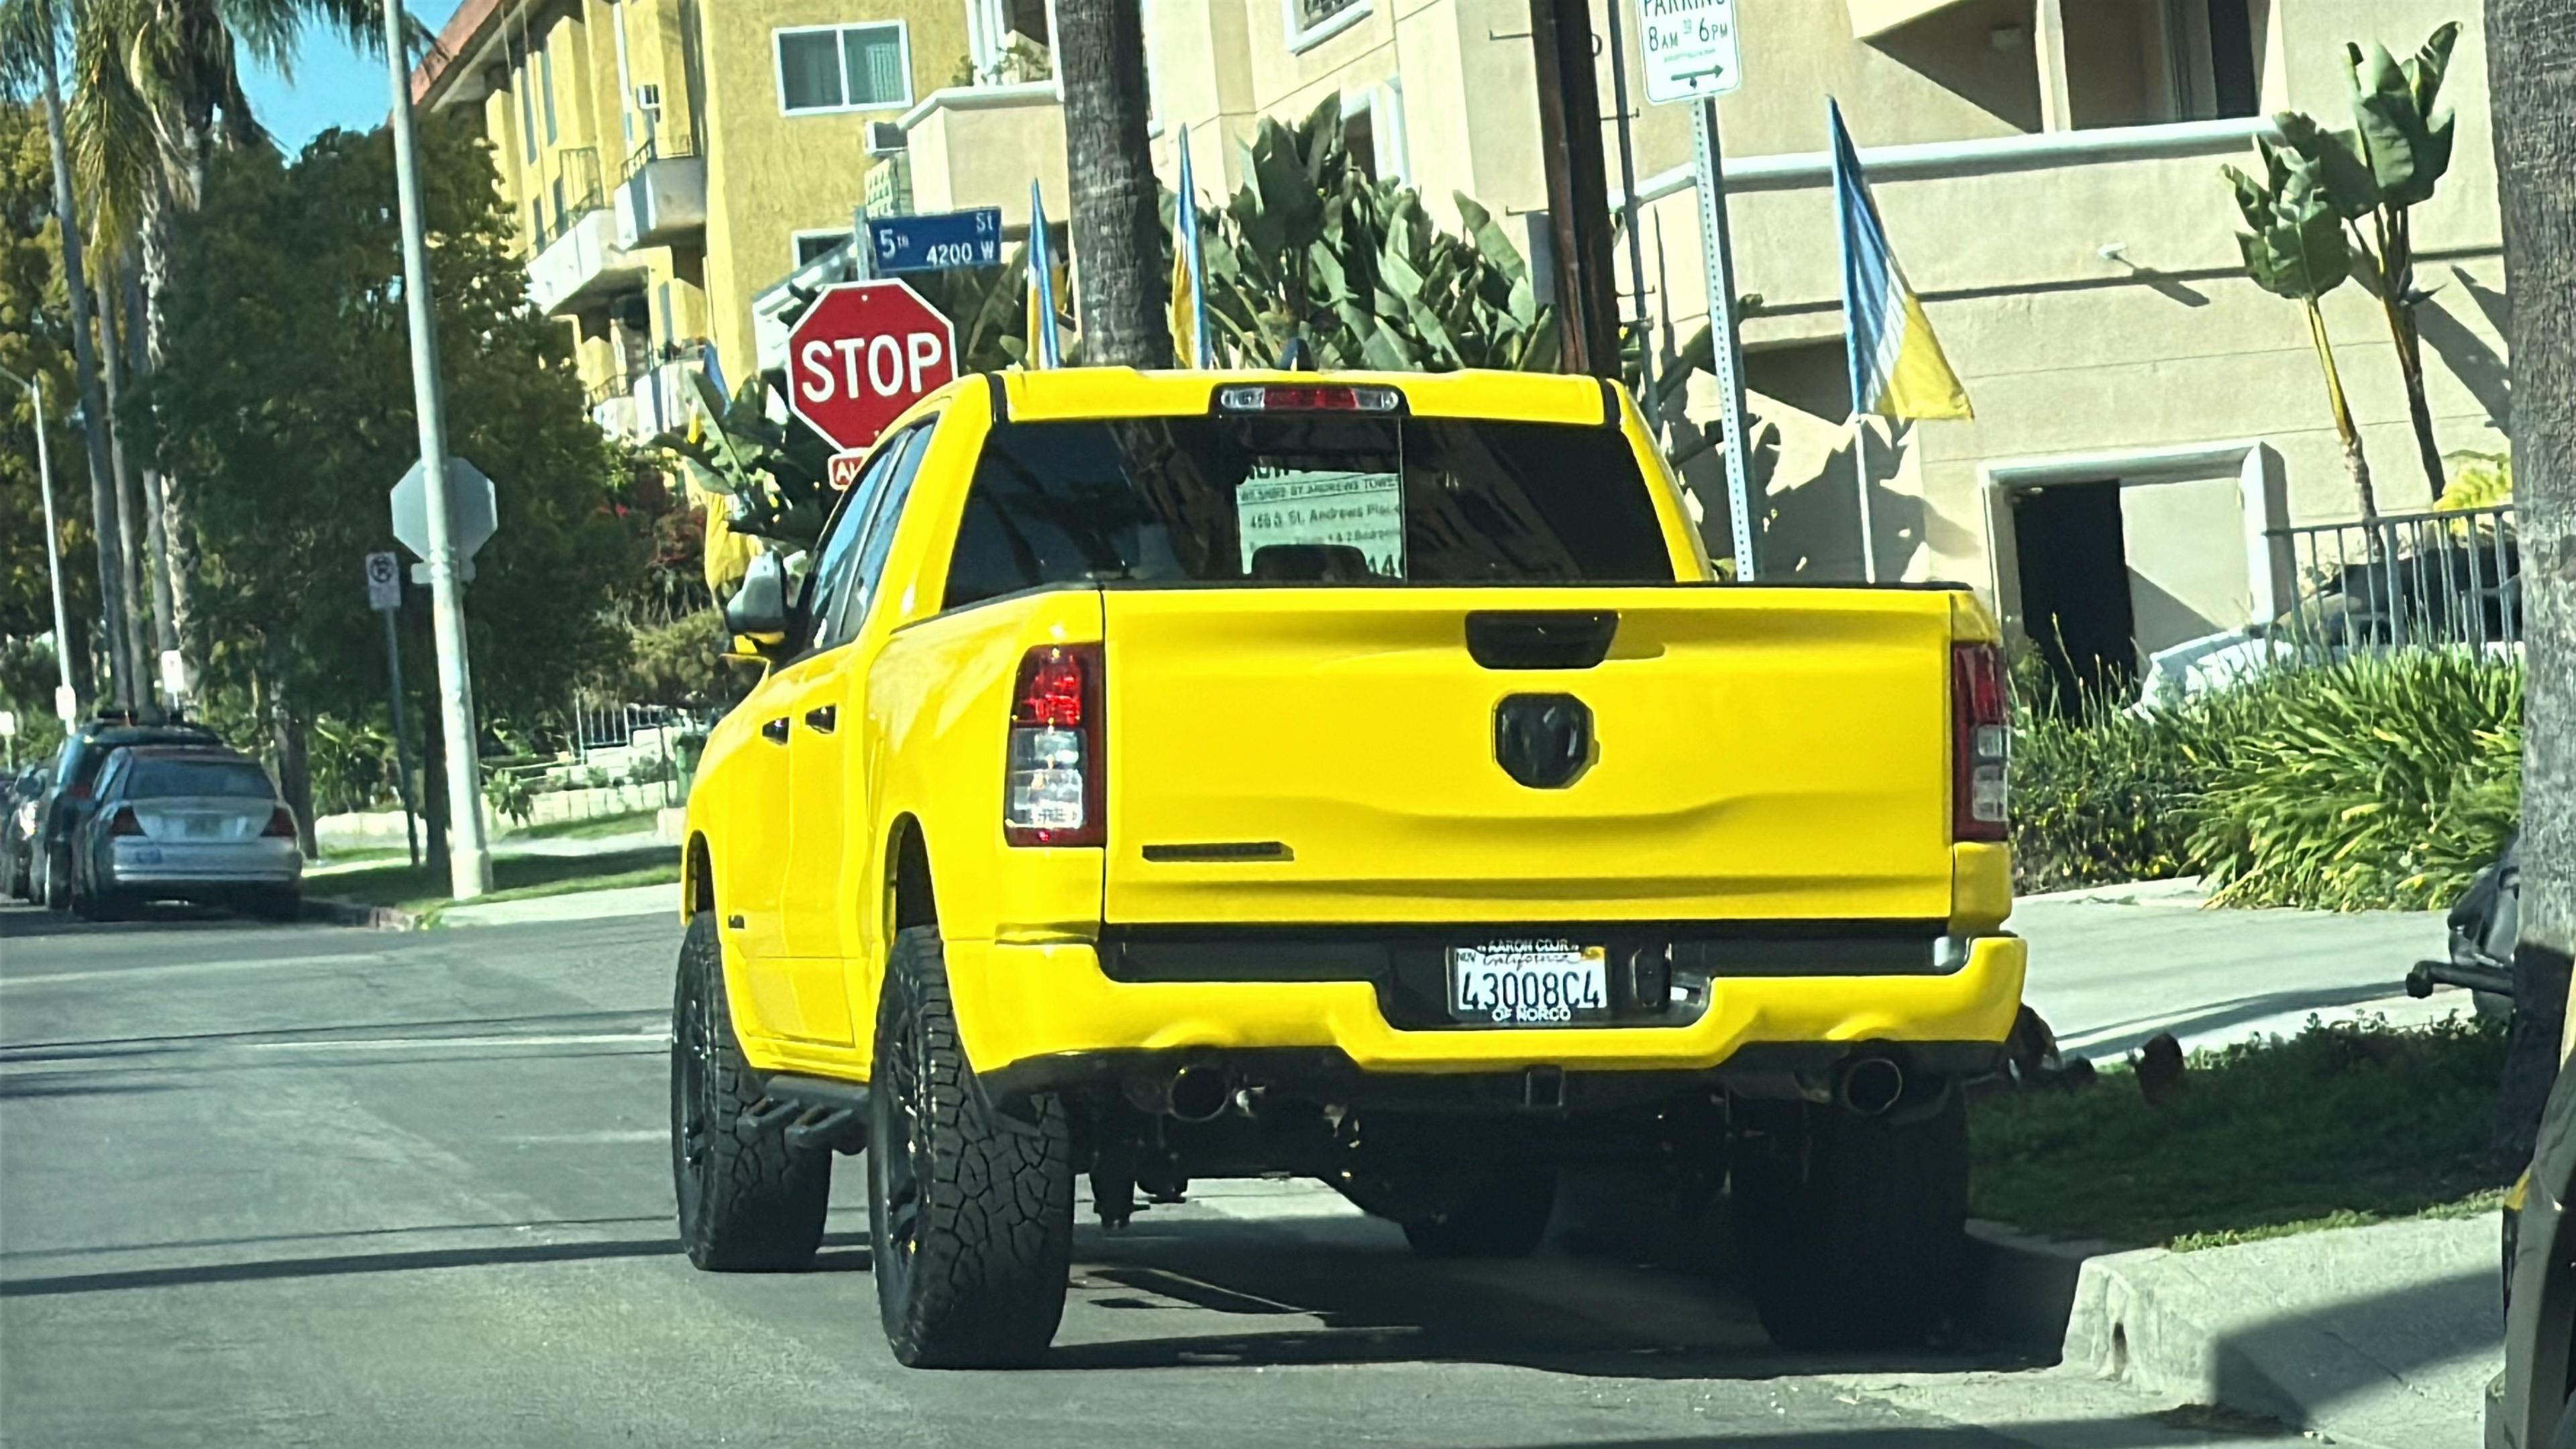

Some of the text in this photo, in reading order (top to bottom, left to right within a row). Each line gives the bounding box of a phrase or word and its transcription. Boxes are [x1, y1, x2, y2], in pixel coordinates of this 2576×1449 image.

[1699, 17, 1727, 42] 6PM
[926, 240, 994, 266] 4200 W
[802, 333, 942, 402] STOP
[1309, 507, 1363, 523] Andrews
[1488, 940, 1533, 953] AARON
[1462, 970, 1601, 1007] 43008C4
[1492, 1007, 1571, 1022] OF NORCO
